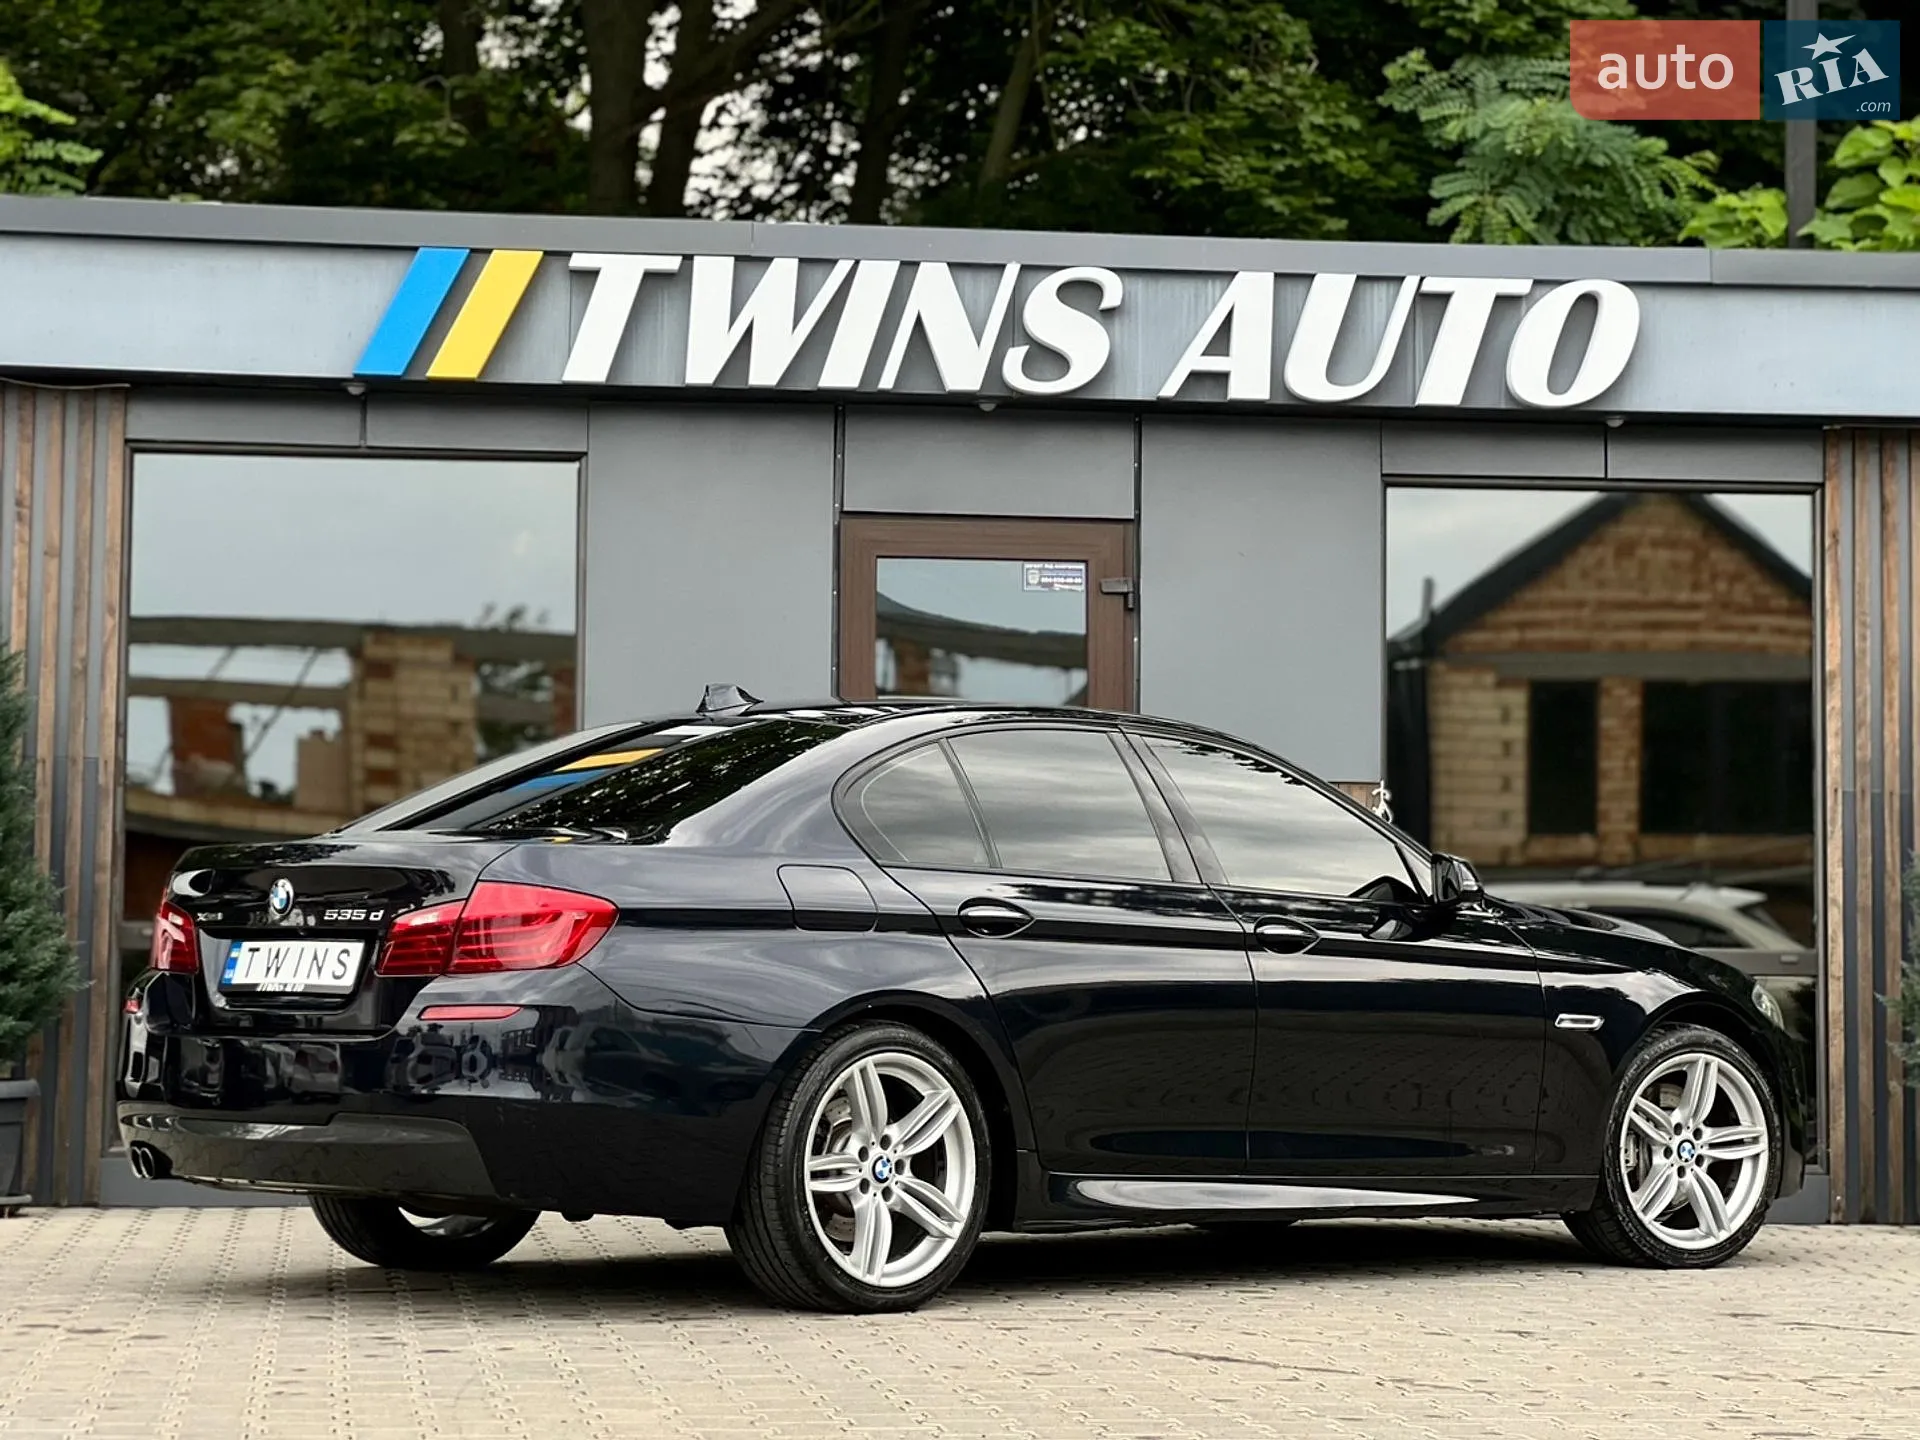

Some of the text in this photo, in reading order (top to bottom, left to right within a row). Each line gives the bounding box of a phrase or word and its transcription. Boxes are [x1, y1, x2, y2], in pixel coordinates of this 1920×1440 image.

[561, 252, 1641, 408] TWINS AUTO
[244, 947, 351, 981] TWINS
